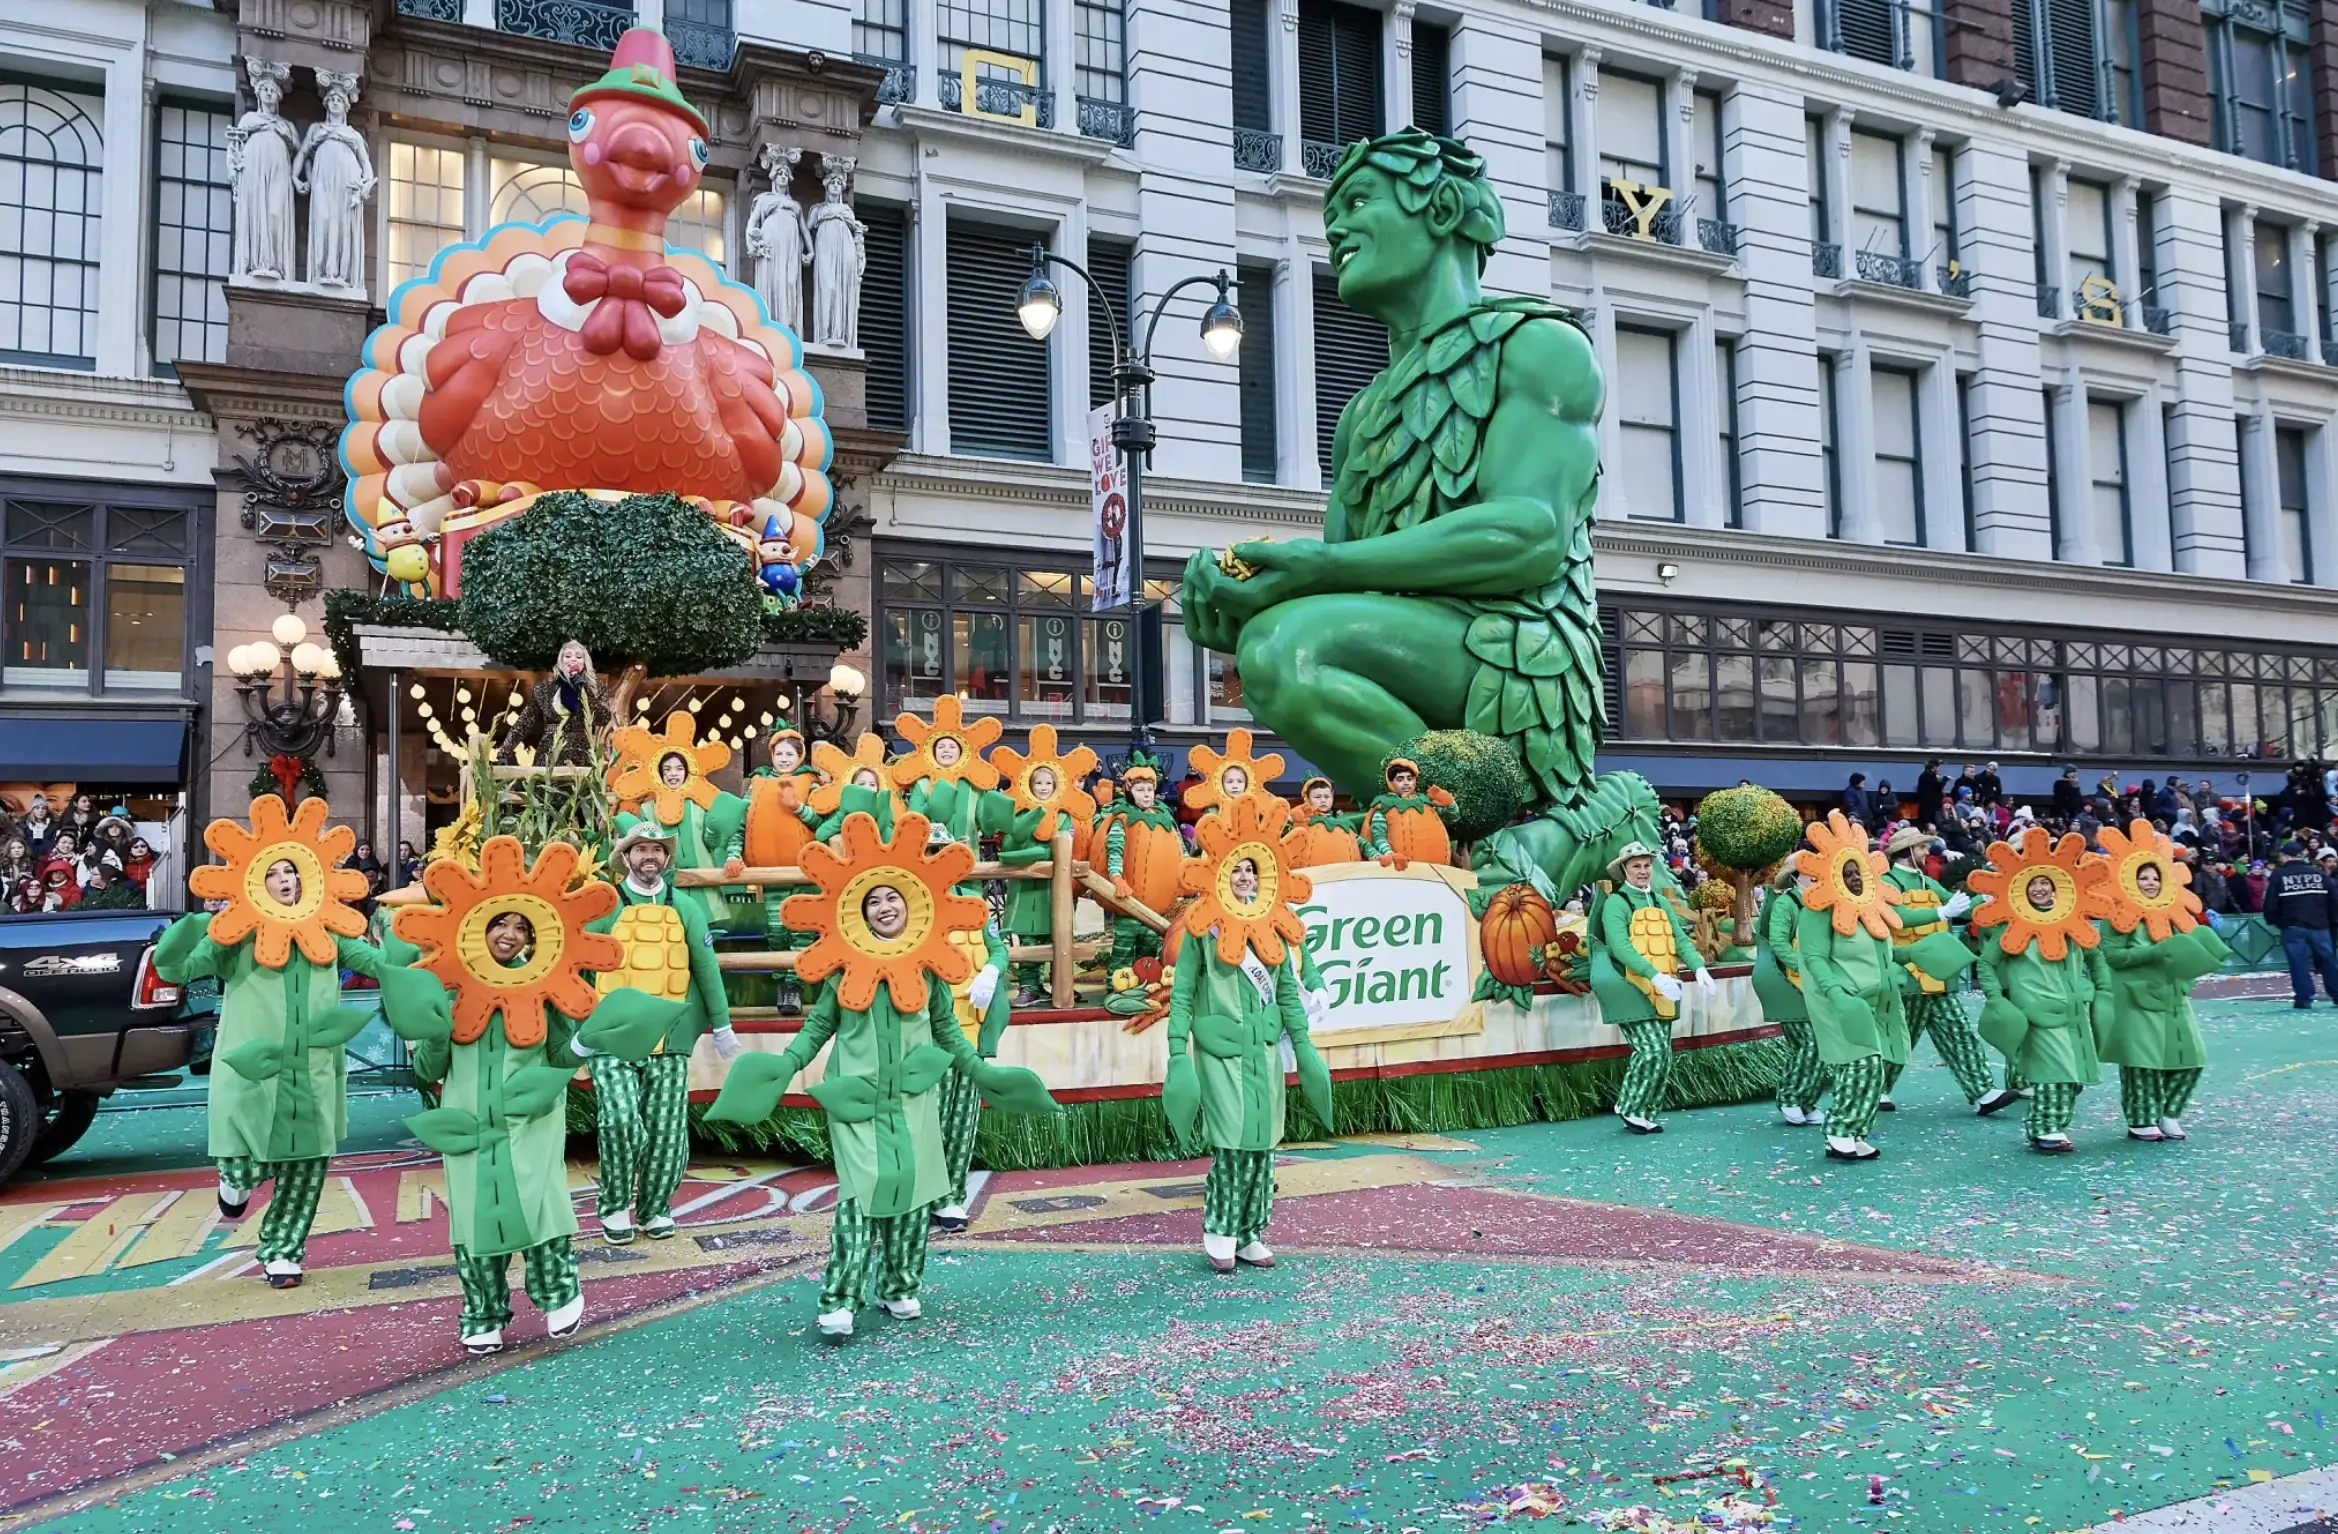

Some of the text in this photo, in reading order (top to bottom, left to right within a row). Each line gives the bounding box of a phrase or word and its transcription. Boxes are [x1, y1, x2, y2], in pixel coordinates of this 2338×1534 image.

[1610, 178, 1674, 242] Y
[1093, 453, 1112, 475] WE
[1094, 467, 1127, 496] LOVE
[2282, 873, 2323, 885] NYPD
[2284, 883, 2324, 891] POLICE
[1294, 905, 1443, 954] Green
[1316, 956, 1451, 1010] Giant
